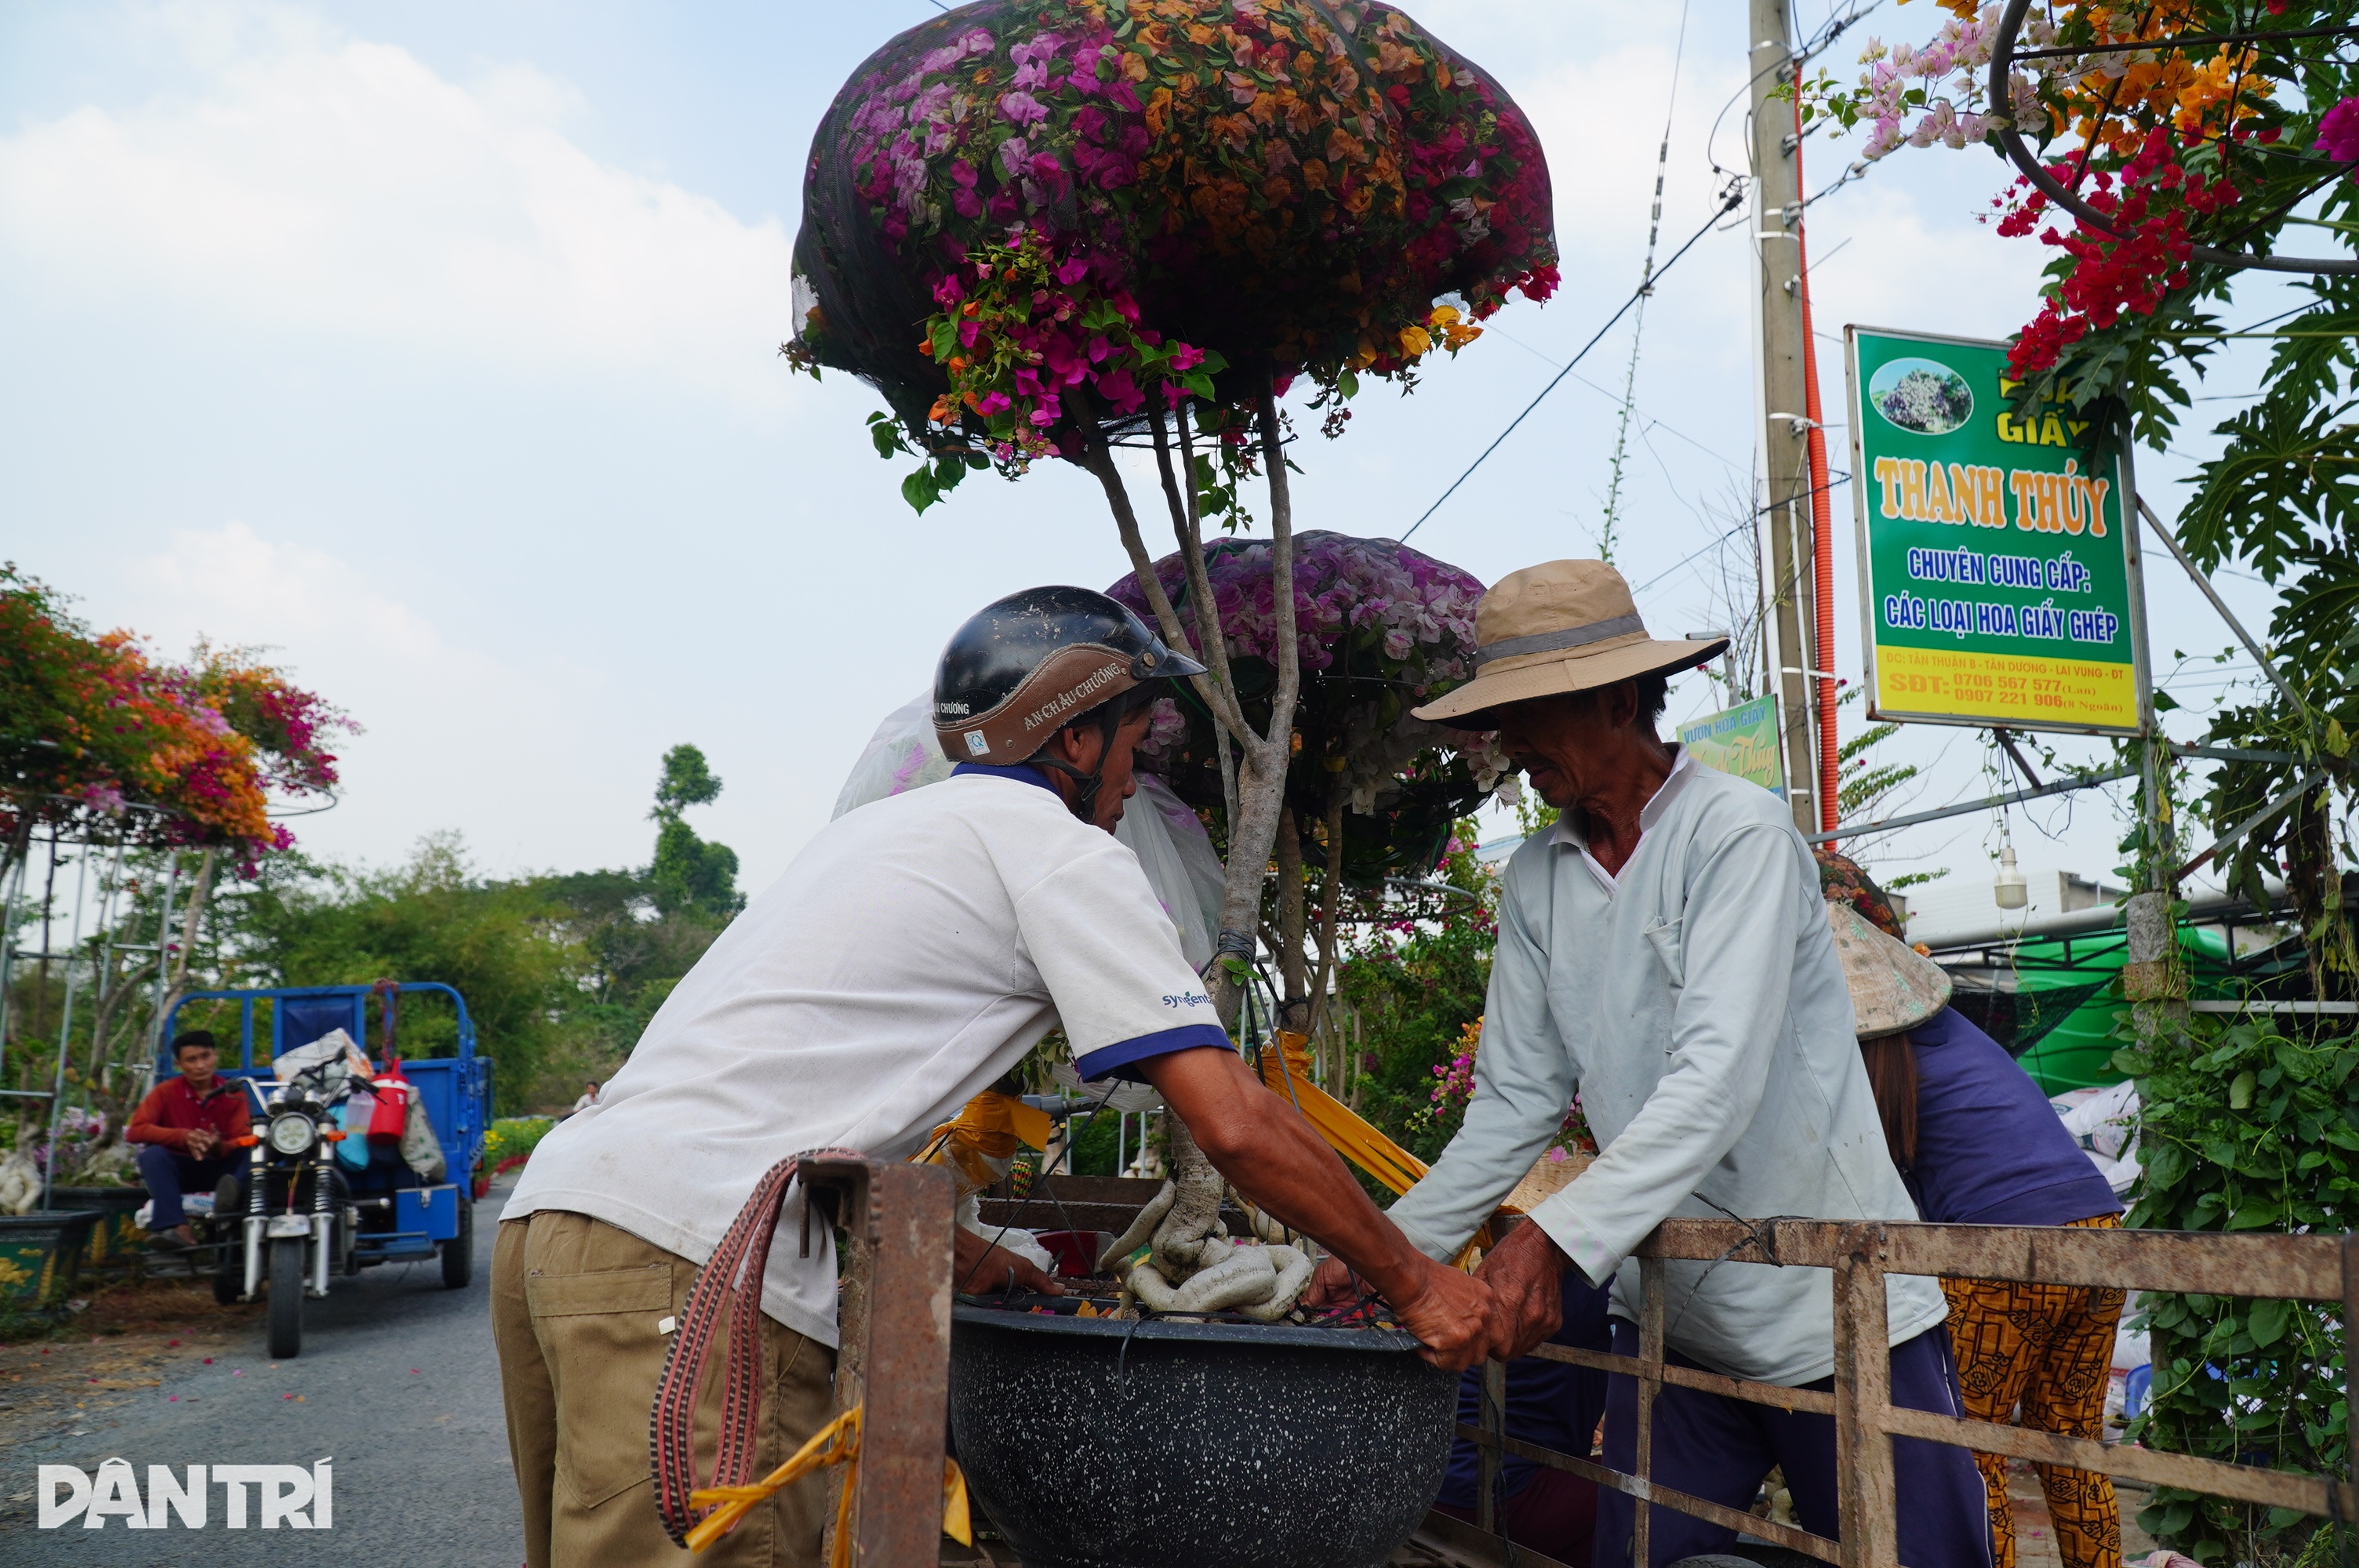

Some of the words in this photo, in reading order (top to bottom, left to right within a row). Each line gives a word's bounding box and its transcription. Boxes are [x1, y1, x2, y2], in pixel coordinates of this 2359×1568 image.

[1874, 456, 2007, 528] THANH
[2009, 458, 2110, 538] THÚY
[1907, 546, 1985, 584] CHUYÊN
[1988, 554, 2042, 589] CUNG
[2047, 550, 2092, 593] CẤP:
[1885, 590, 1925, 629] CÁC
[1928, 598, 1973, 639] LOẠI
[1976, 601, 2019, 637] HOA
[2019, 597, 2064, 640] GIẤY
[2069, 606, 2118, 644] GHÉP
[1886, 652, 1906, 664] ĐC:
[1908, 652, 1928, 666] TÂN
[1932, 655, 1966, 670] THUẬN
[1970, 659, 1976, 669] B
[1985, 658, 2005, 671] TÂN
[2008, 661, 2047, 673] DƯƠNG
[2056, 665, 2070, 676] LAI
[2074, 666, 2103, 679] VUNG
[2111, 670, 2123, 680] ĐT
[1889, 673, 1950, 695] SĐT:
[1954, 673, 1993, 688] 0706
[1998, 677, 2027, 690] 567
[2033, 679, 2061, 692] 577
[940, 701, 970, 715] CHƯƠNG
[1954, 688, 1993, 703] 0907
[1999, 691, 2026, 705] 221
[2034, 694, 2063, 709] 906
[1715, 715, 1737, 735] HOA
